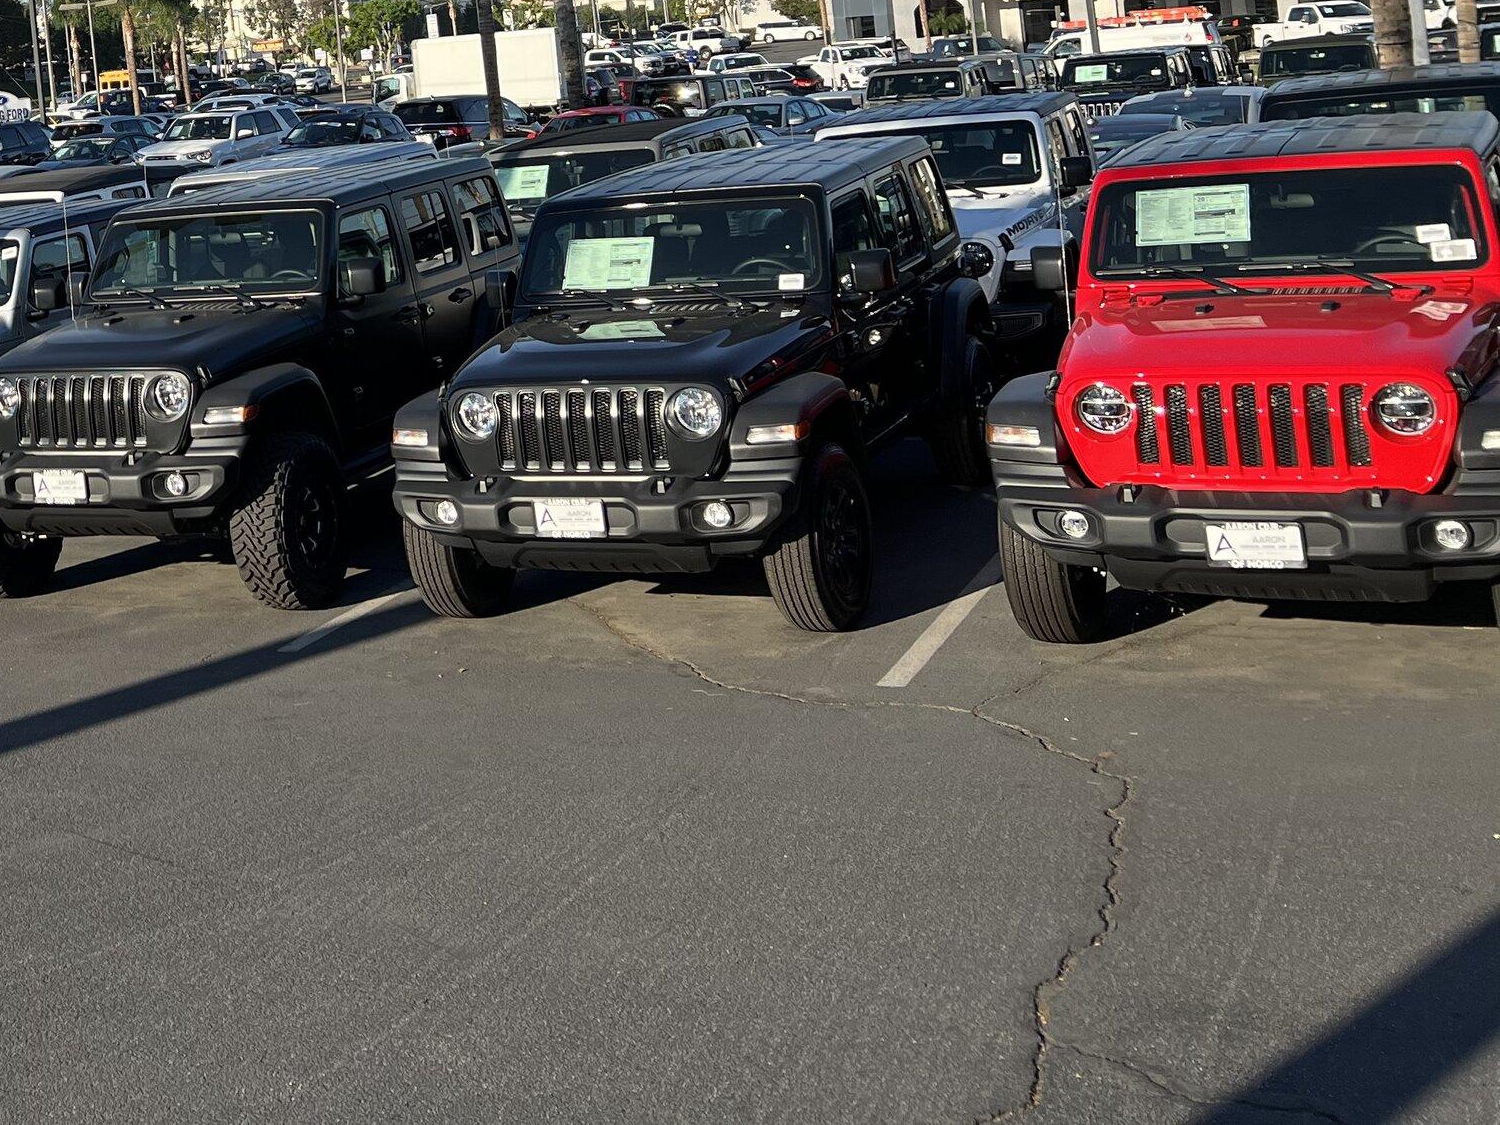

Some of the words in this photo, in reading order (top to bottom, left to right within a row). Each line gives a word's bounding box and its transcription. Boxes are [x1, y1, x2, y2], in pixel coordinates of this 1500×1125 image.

[6, 107, 29, 122] FORD
[1225, 522, 1257, 531] AARON
[1252, 536, 1285, 544] AARON
[1230, 559, 1245, 569] OF
[1246, 559, 1284, 569] NORCO
